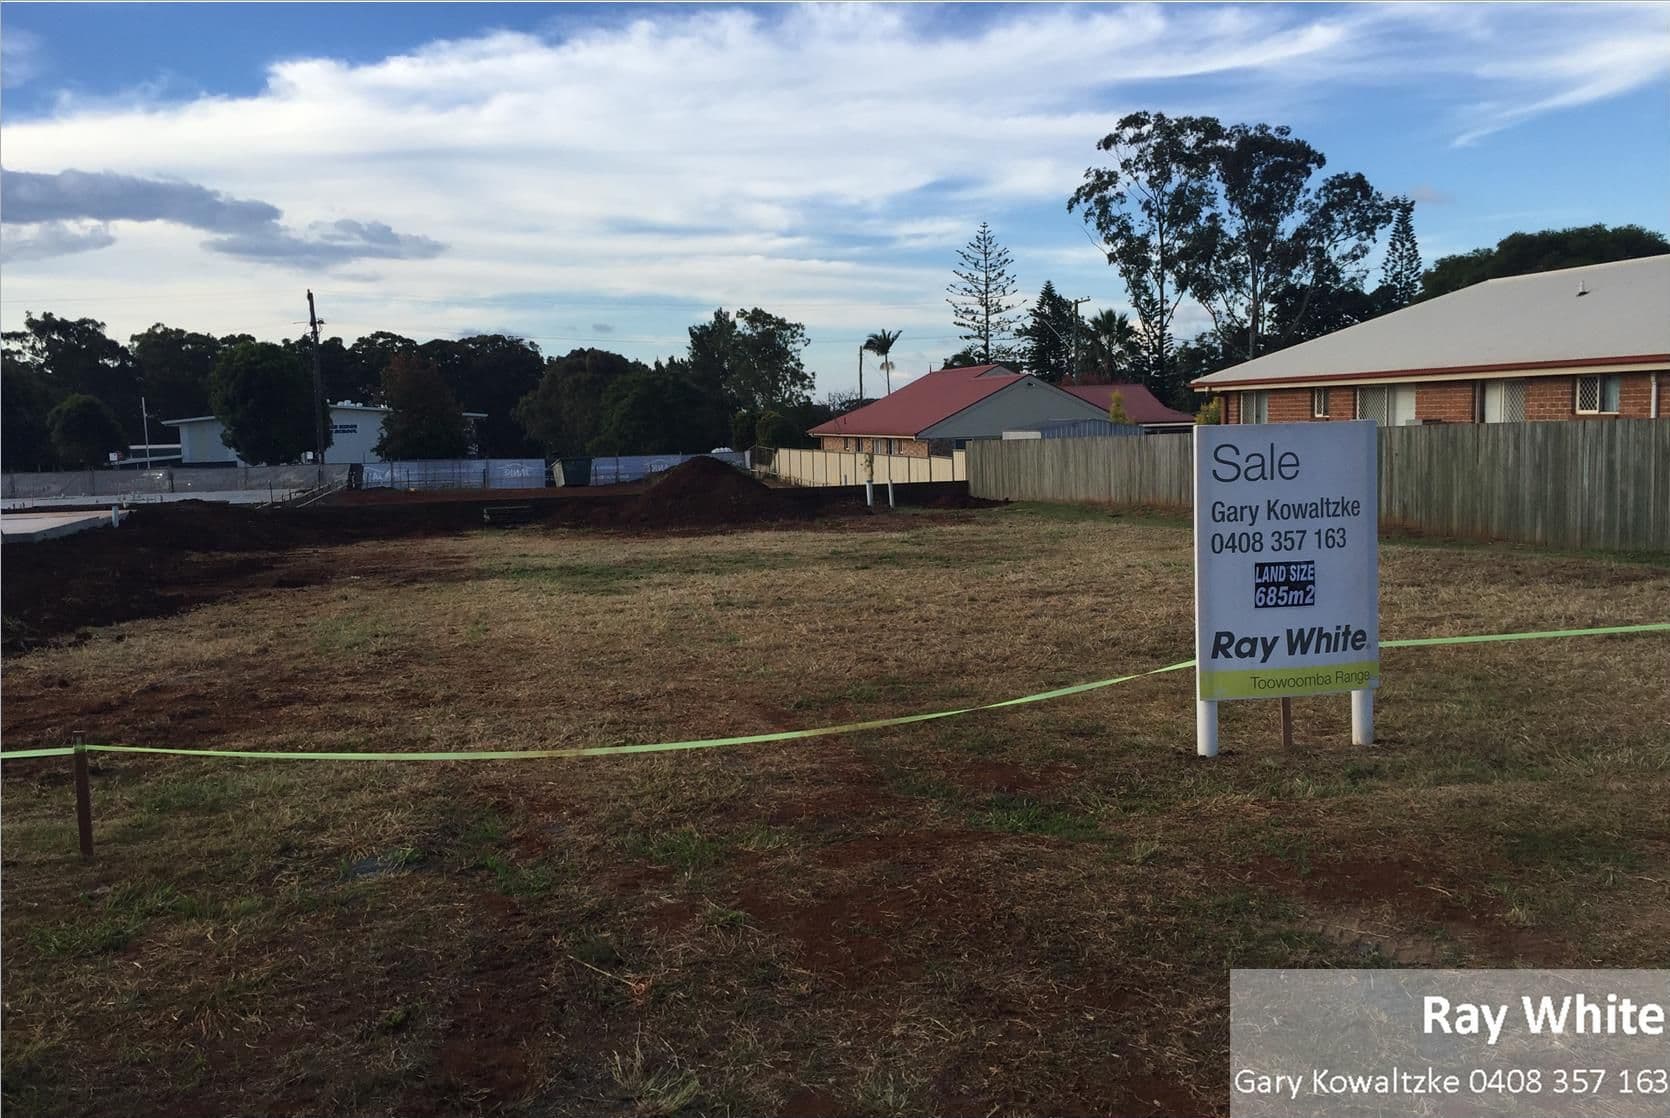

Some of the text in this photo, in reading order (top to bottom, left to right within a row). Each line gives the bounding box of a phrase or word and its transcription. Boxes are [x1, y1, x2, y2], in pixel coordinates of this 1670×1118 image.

[1212, 443, 1300, 483] Sale
[1212, 496, 1361, 526] Gary Kowaltzke
[1211, 528, 1347, 554] 0408 357 163
[1255, 564, 1315, 584] LAND SIZE
[1255, 584, 1315, 607] 685m2
[1211, 624, 1368, 663] Ray White
[1250, 670, 1371, 690] Toowoomba Range
